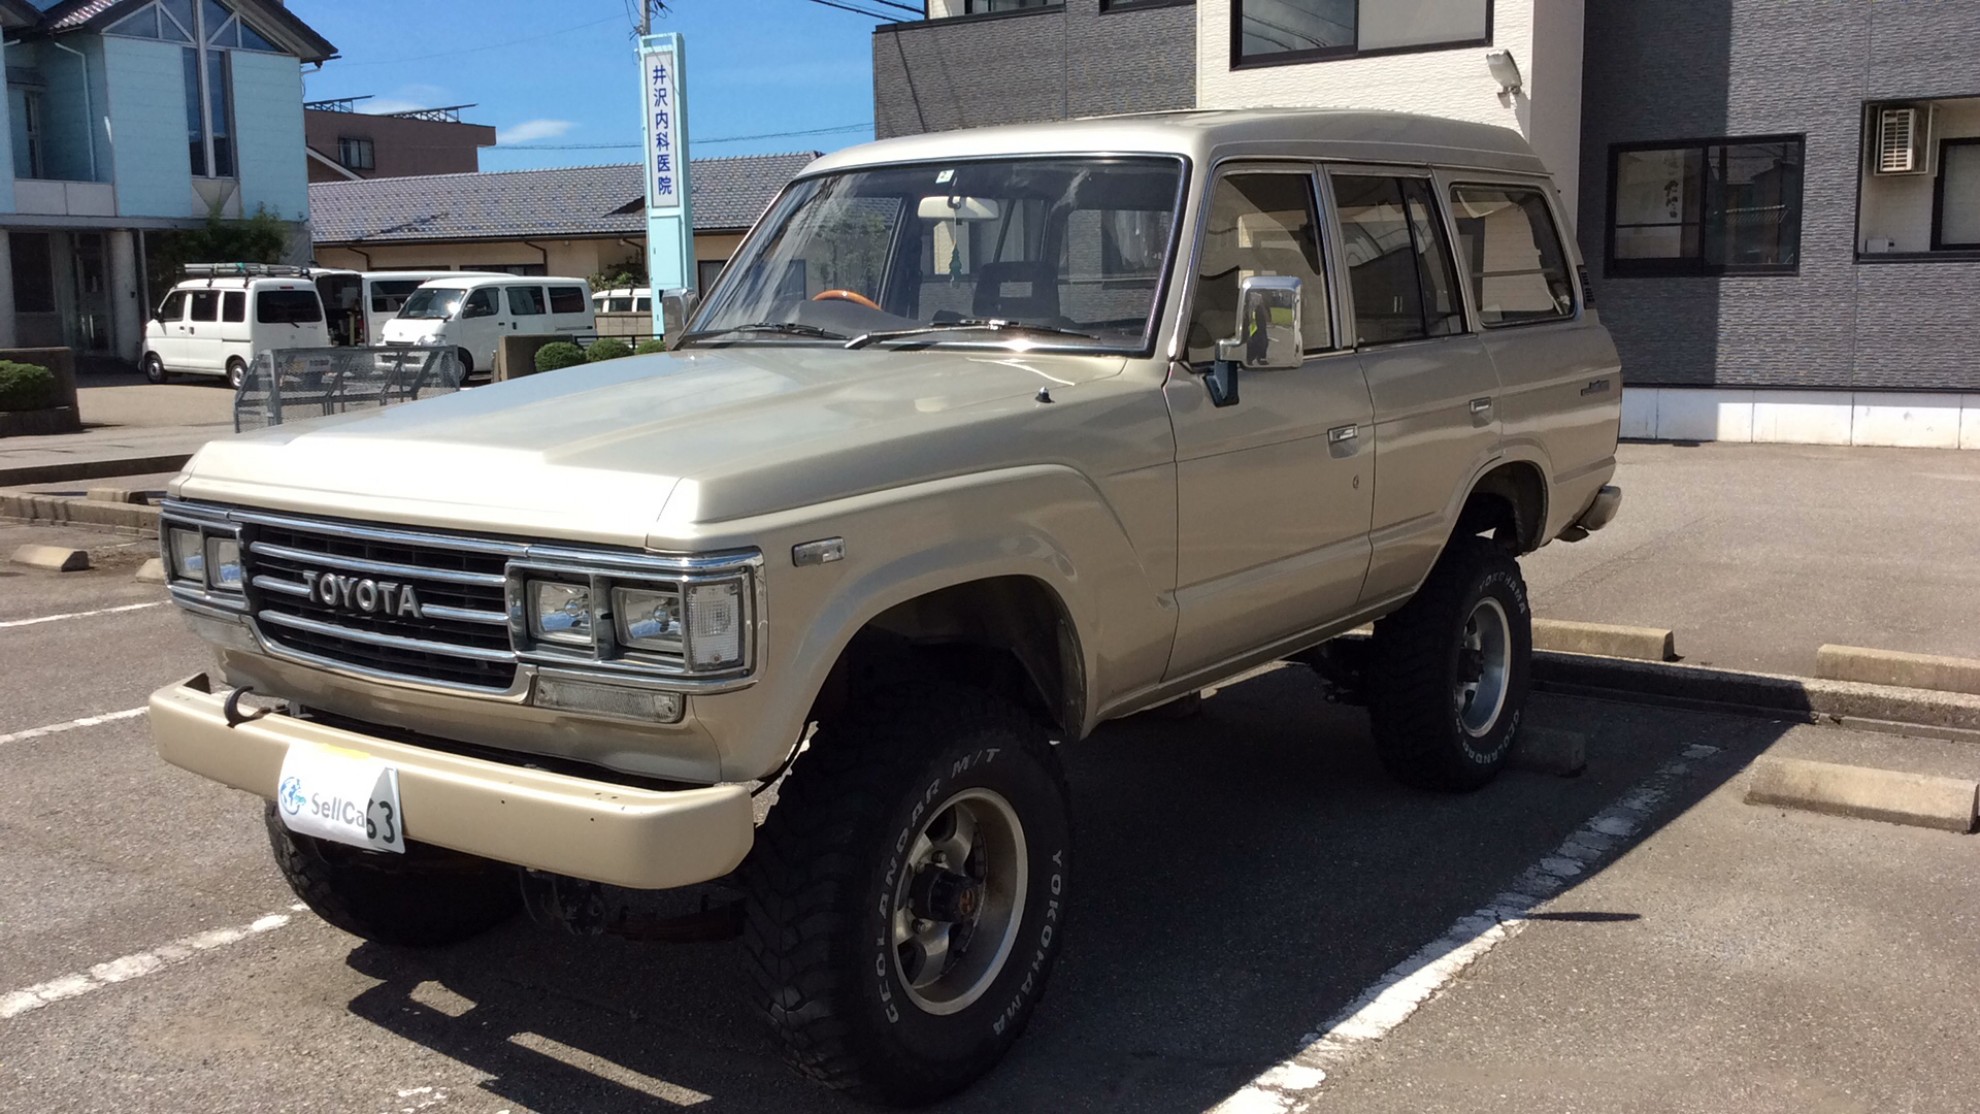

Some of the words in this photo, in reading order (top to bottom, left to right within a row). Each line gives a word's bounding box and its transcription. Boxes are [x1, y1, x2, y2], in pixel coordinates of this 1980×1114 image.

[653, 65, 672, 195] 井沢内科医院
[303, 569, 420, 618] TOYOTA
[876, 778, 940, 1024] GEOLANDAR
[952, 748, 1000, 778] M/T
[992, 848, 1063, 1036] YOKOHAMA
